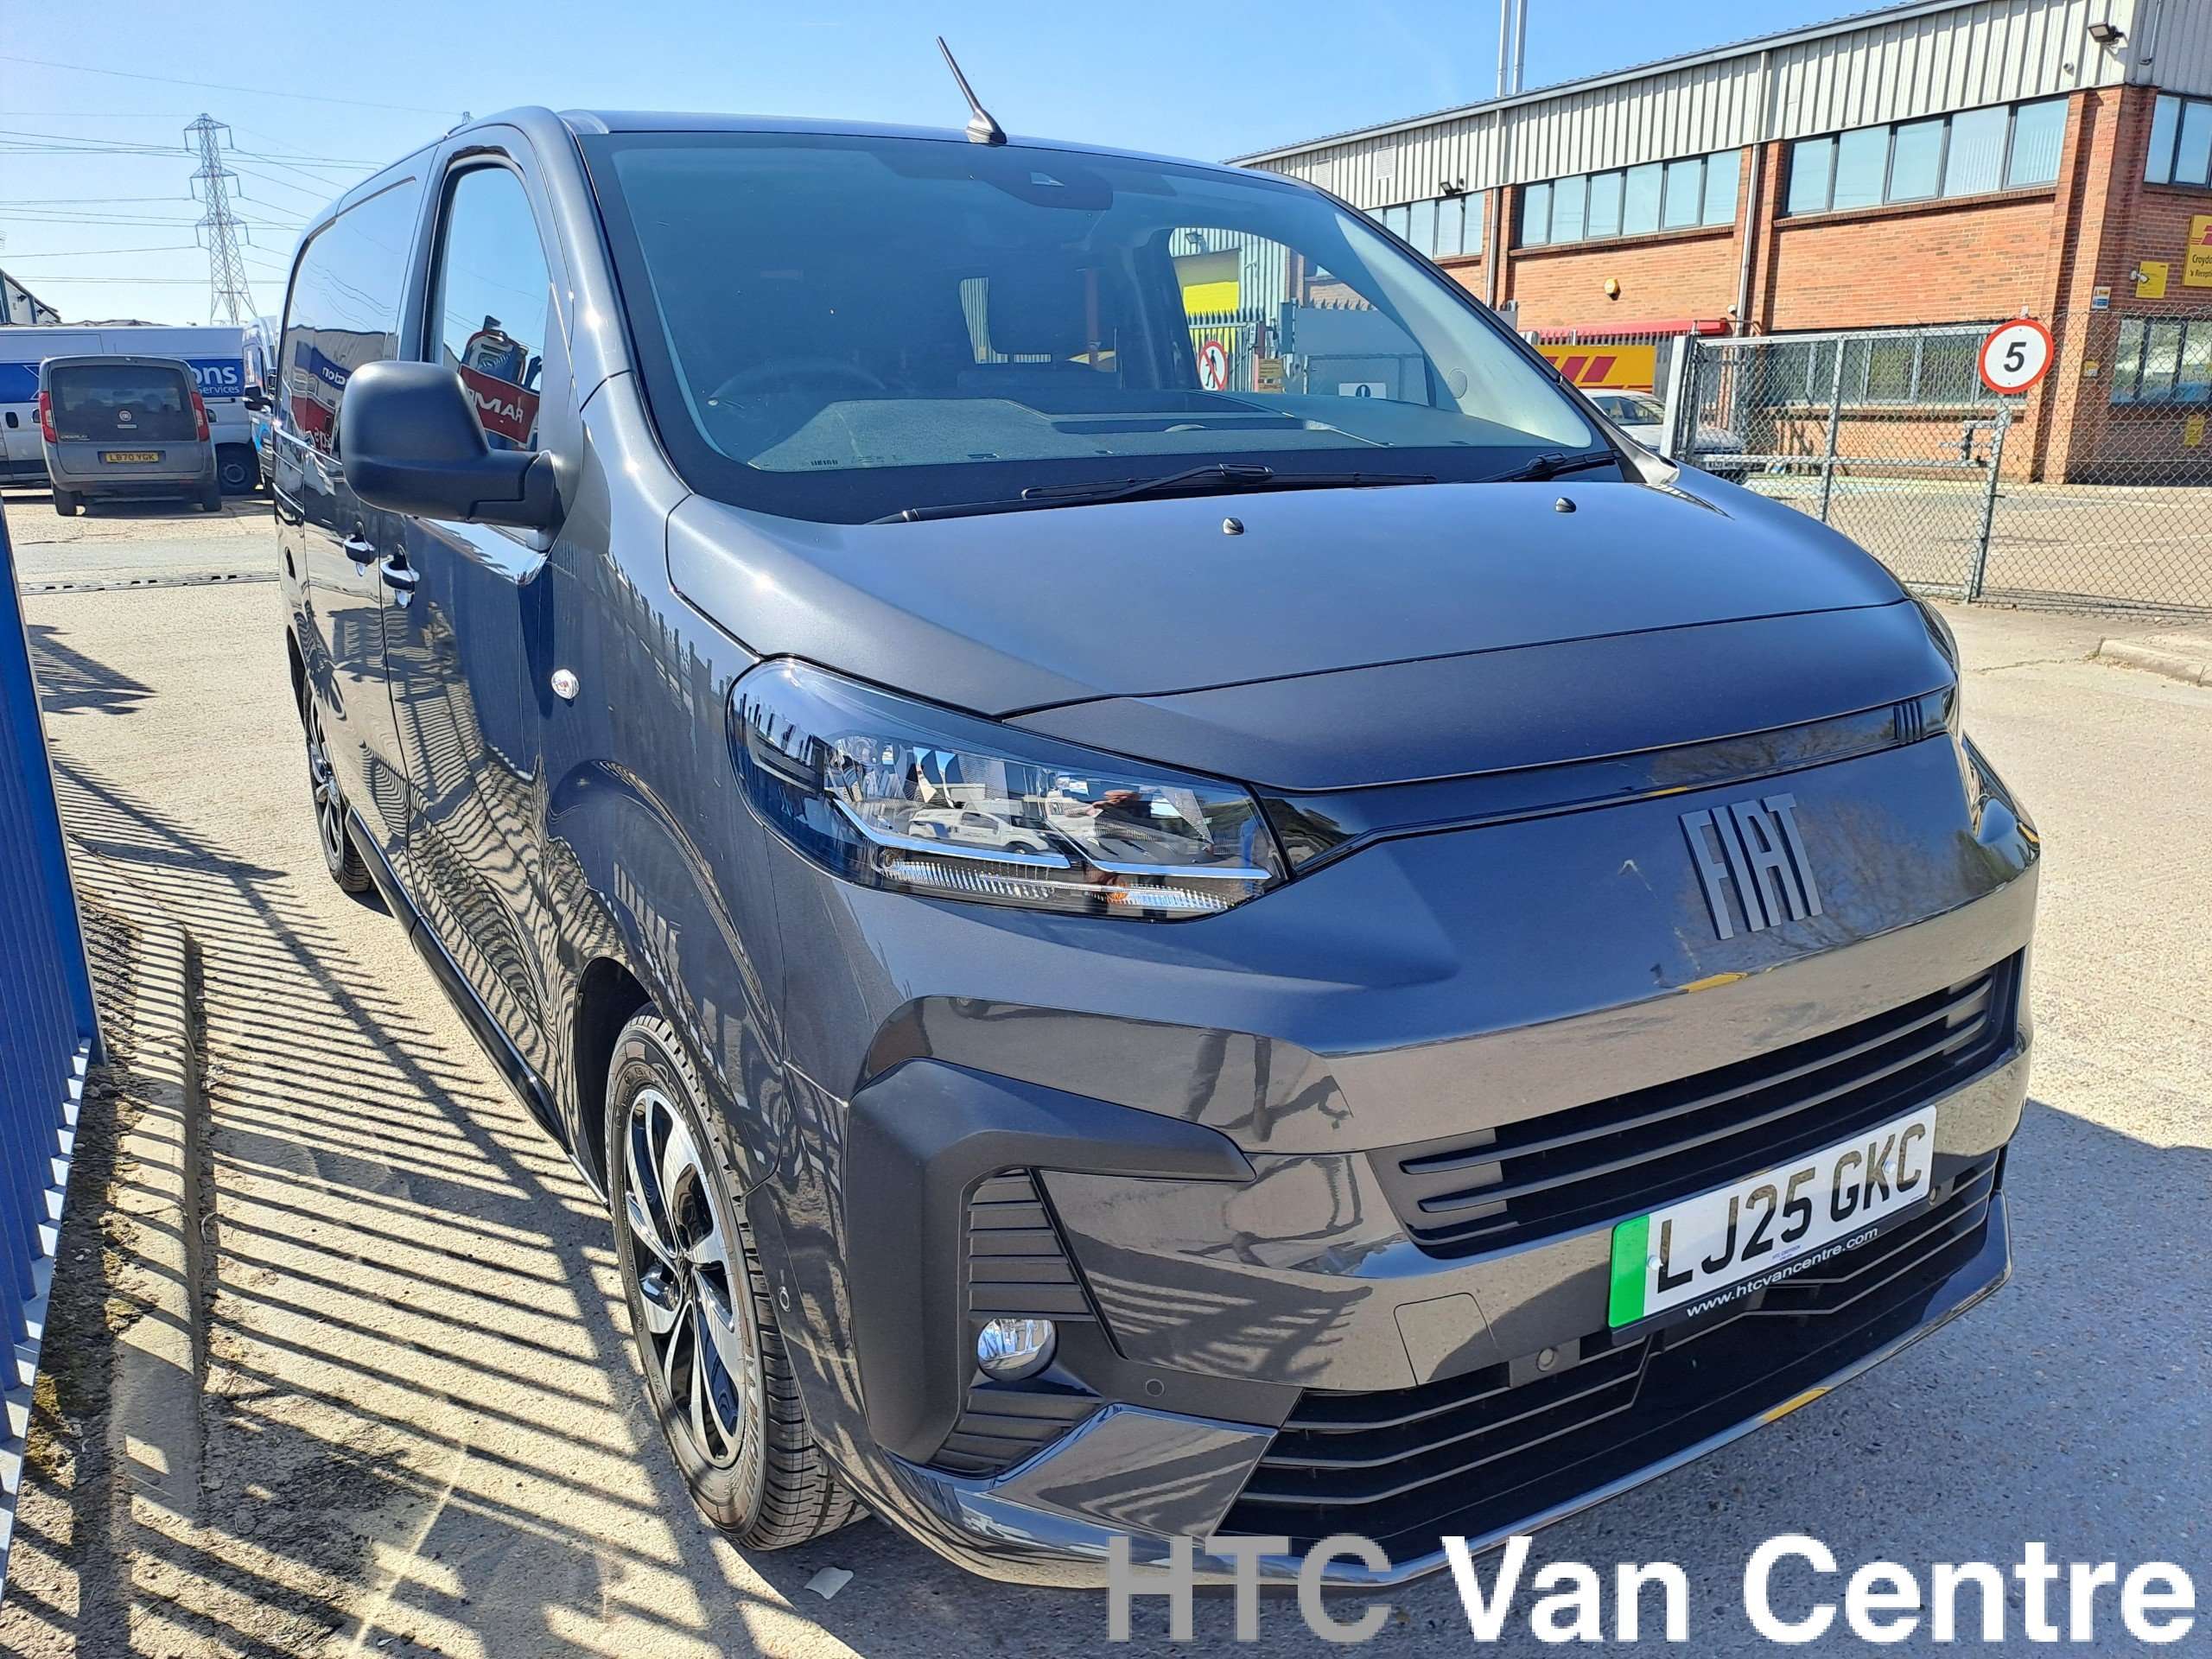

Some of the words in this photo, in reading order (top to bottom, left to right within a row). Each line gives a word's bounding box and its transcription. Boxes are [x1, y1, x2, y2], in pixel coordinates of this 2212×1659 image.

[2003, 341, 2027, 372] 5
[1679, 792, 1824, 941] FIAT
[1656, 1166, 1817, 1294] LJ25
[1830, 1122, 1927, 1223] GKC
[1686, 1227, 1878, 1319] www.htcvancentre.com
